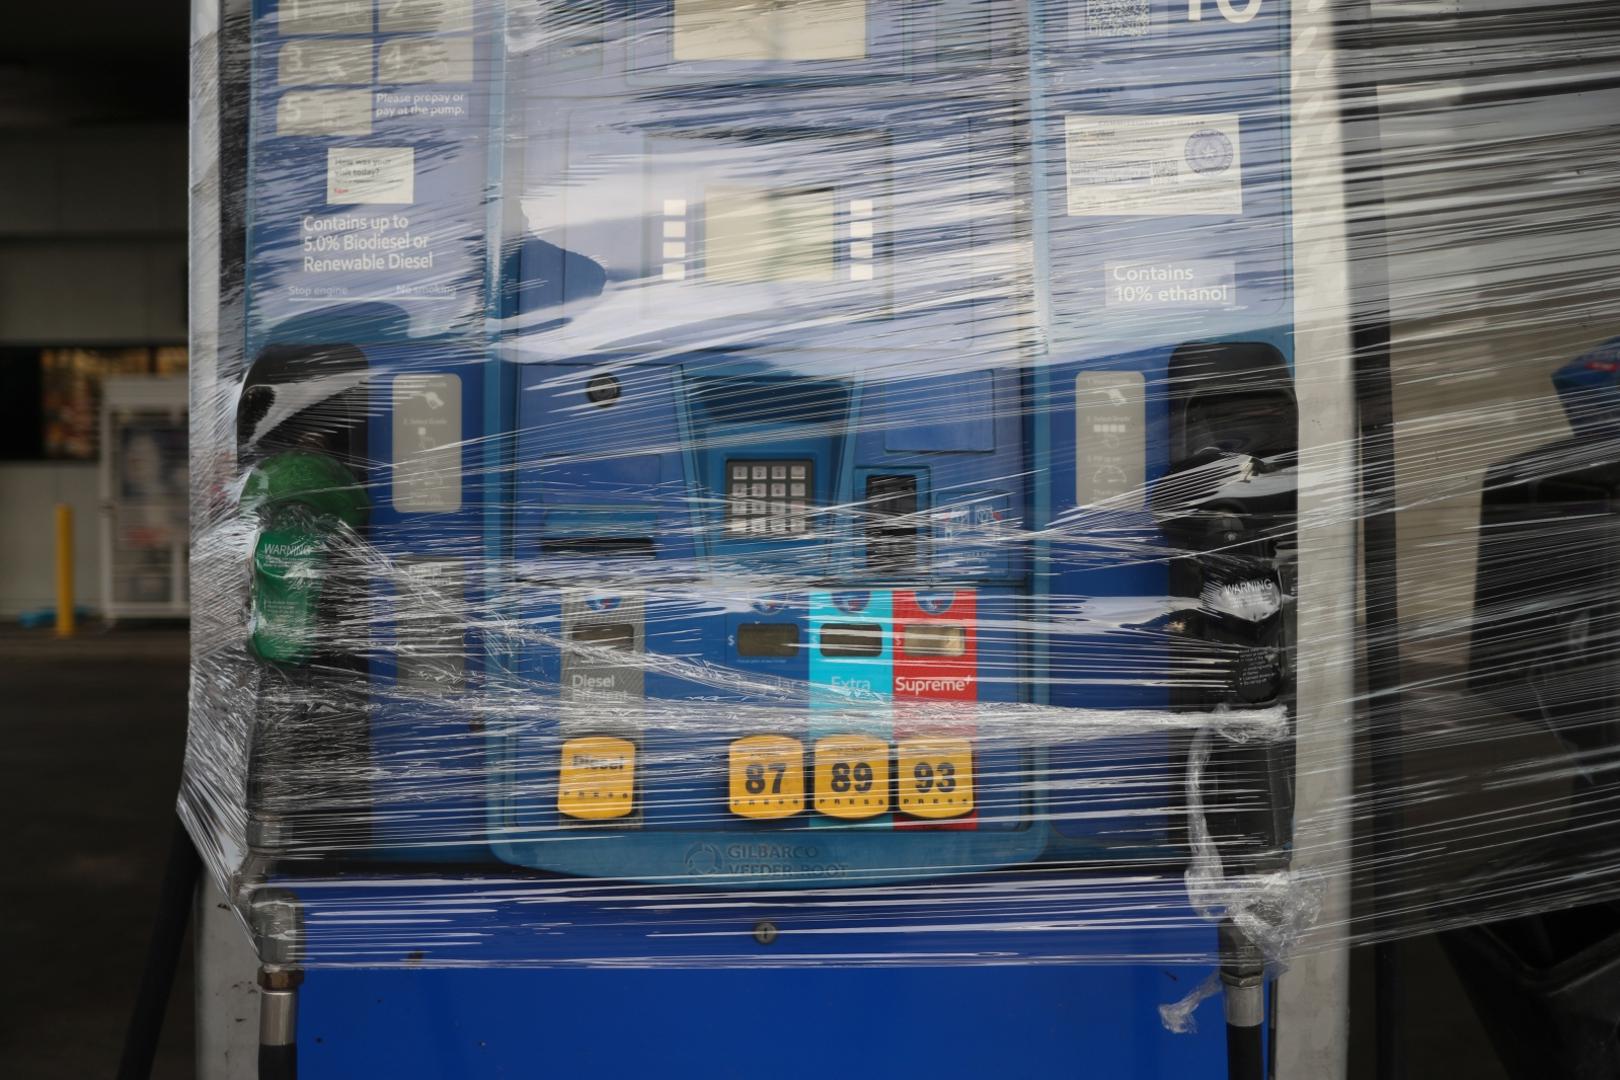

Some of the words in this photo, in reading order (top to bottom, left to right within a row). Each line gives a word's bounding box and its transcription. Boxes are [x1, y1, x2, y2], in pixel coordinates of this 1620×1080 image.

[376, 93, 411, 102] Please
[414, 94, 450, 104] prepay
[376, 107, 396, 118] pay
[410, 105, 428, 113] the
[430, 106, 465, 117] pump.
[303, 215, 367, 231] Contains
[370, 217, 389, 233] up
[392, 214, 409, 229] to
[303, 235, 340, 252] 5.0%
[343, 233, 410, 250] Biodiesel
[413, 235, 429, 248] or
[303, 254, 385, 272] Renewable
[388, 252, 433, 269] Diesel
[1113, 264, 1194, 281] Contains
[288, 286, 312, 297] Stop
[1114, 285, 1153, 302] 10%
[1158, 284, 1228, 301] ethanol
[264, 543, 311, 556] WARNING
[1225, 578, 1273, 594] WARNING
[727, 634, 735, 646] $
[572, 674, 615, 687] Diesel
[831, 676, 871, 690] Extra
[745, 763, 786, 794] 87
[831, 762, 873, 793] 89
[914, 762, 956, 793] 93
[727, 844, 818, 859] GILBARCO
[728, 863, 849, 878] VEEDERROOT
